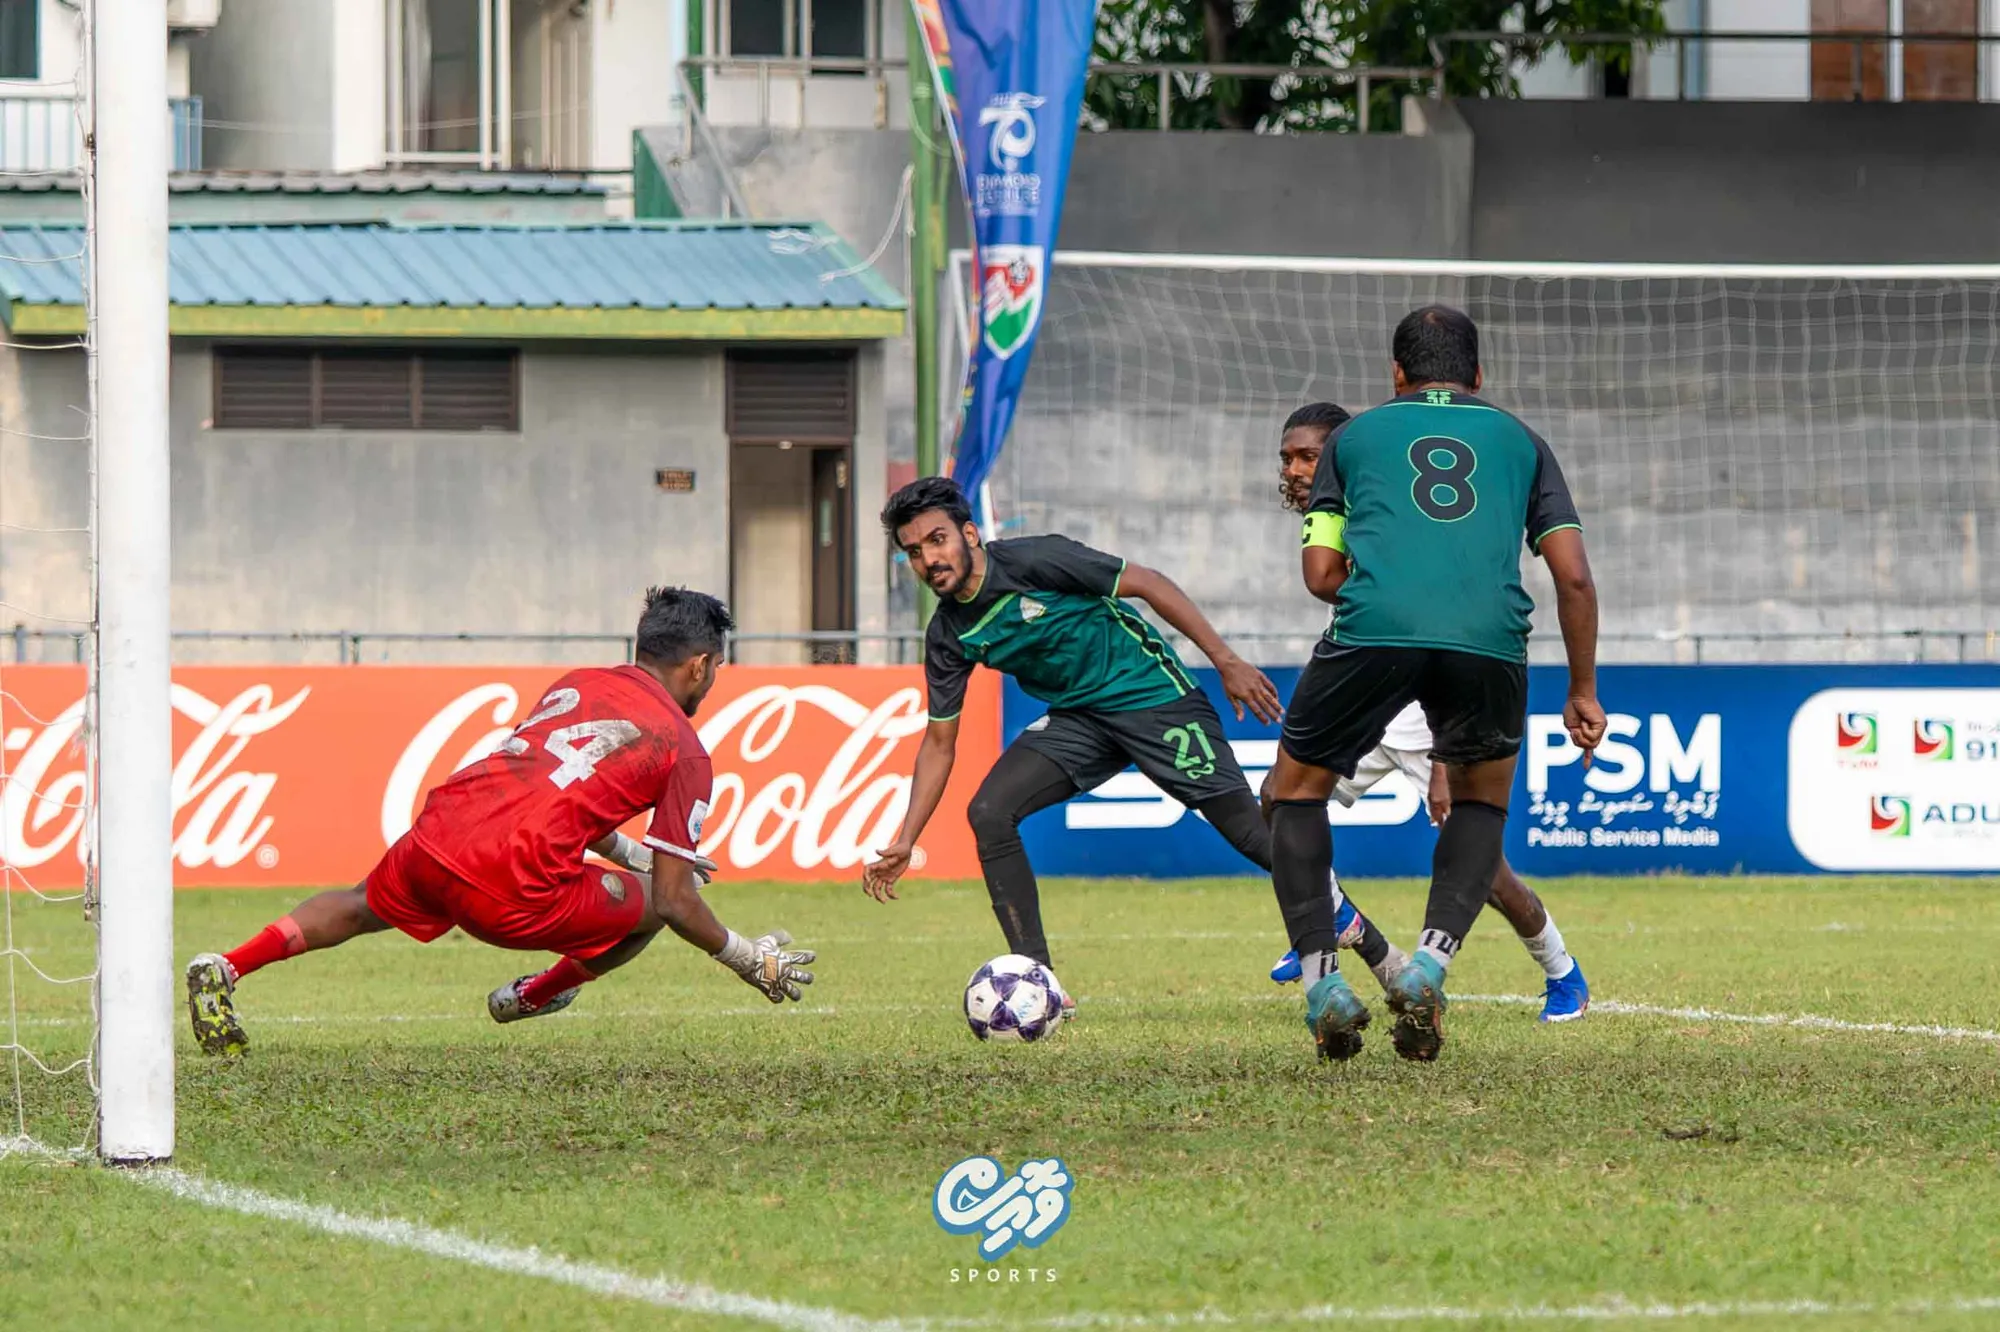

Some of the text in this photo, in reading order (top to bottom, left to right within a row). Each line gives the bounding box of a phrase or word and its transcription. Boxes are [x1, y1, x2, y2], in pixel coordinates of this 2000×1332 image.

[1407, 435, 1478, 523] 8
[502, 687, 642, 790] 24
[1162, 722, 1216, 770] 21
[1527, 713, 1722, 793] PSM
[1527, 827, 1720, 846] Public Service Media
